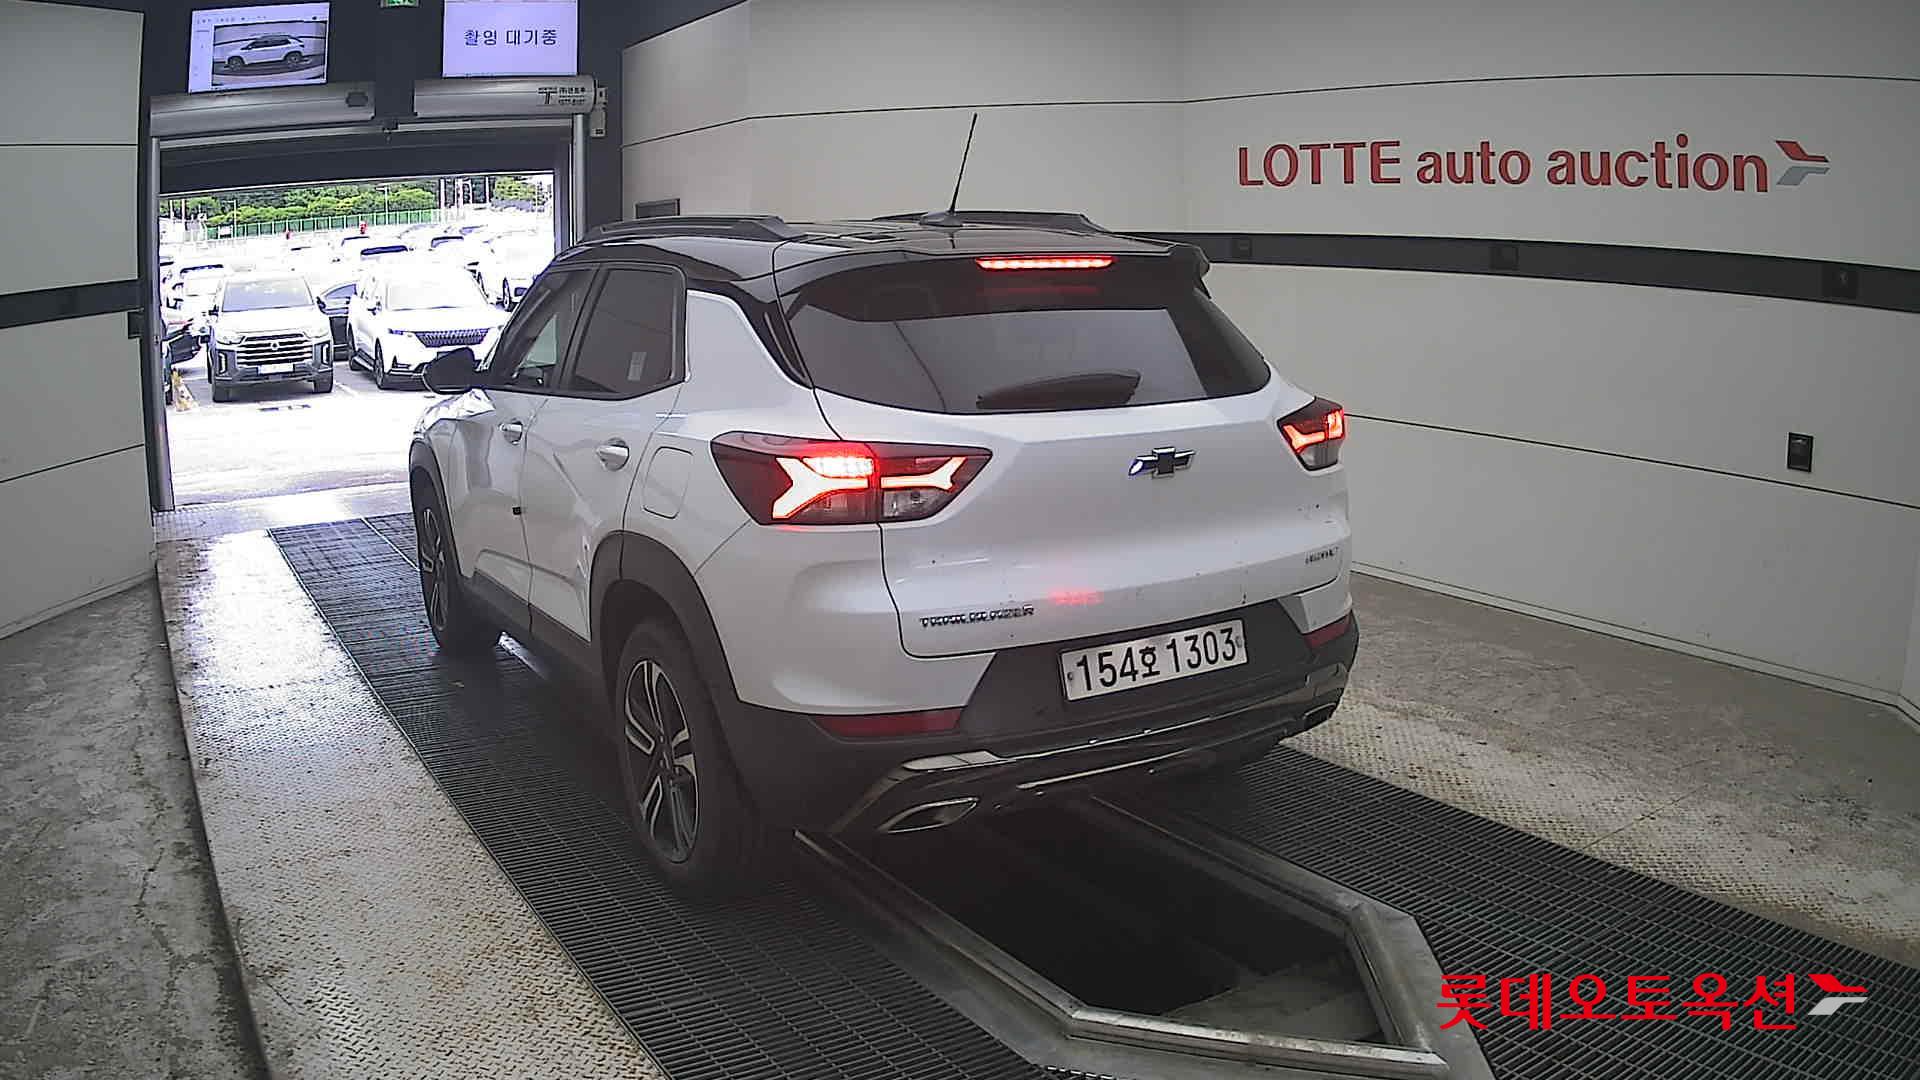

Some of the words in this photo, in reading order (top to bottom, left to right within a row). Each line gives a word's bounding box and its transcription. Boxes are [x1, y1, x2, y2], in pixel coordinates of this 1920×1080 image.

[505, 29, 557, 46] 대기중
[1239, 140, 1401, 187] LOTTE
[1416, 141, 1531, 185] auto
[1547, 133, 1768, 193] auction
[1076, 646, 1161, 691] 154호
[1166, 627, 1236, 673] 1303
